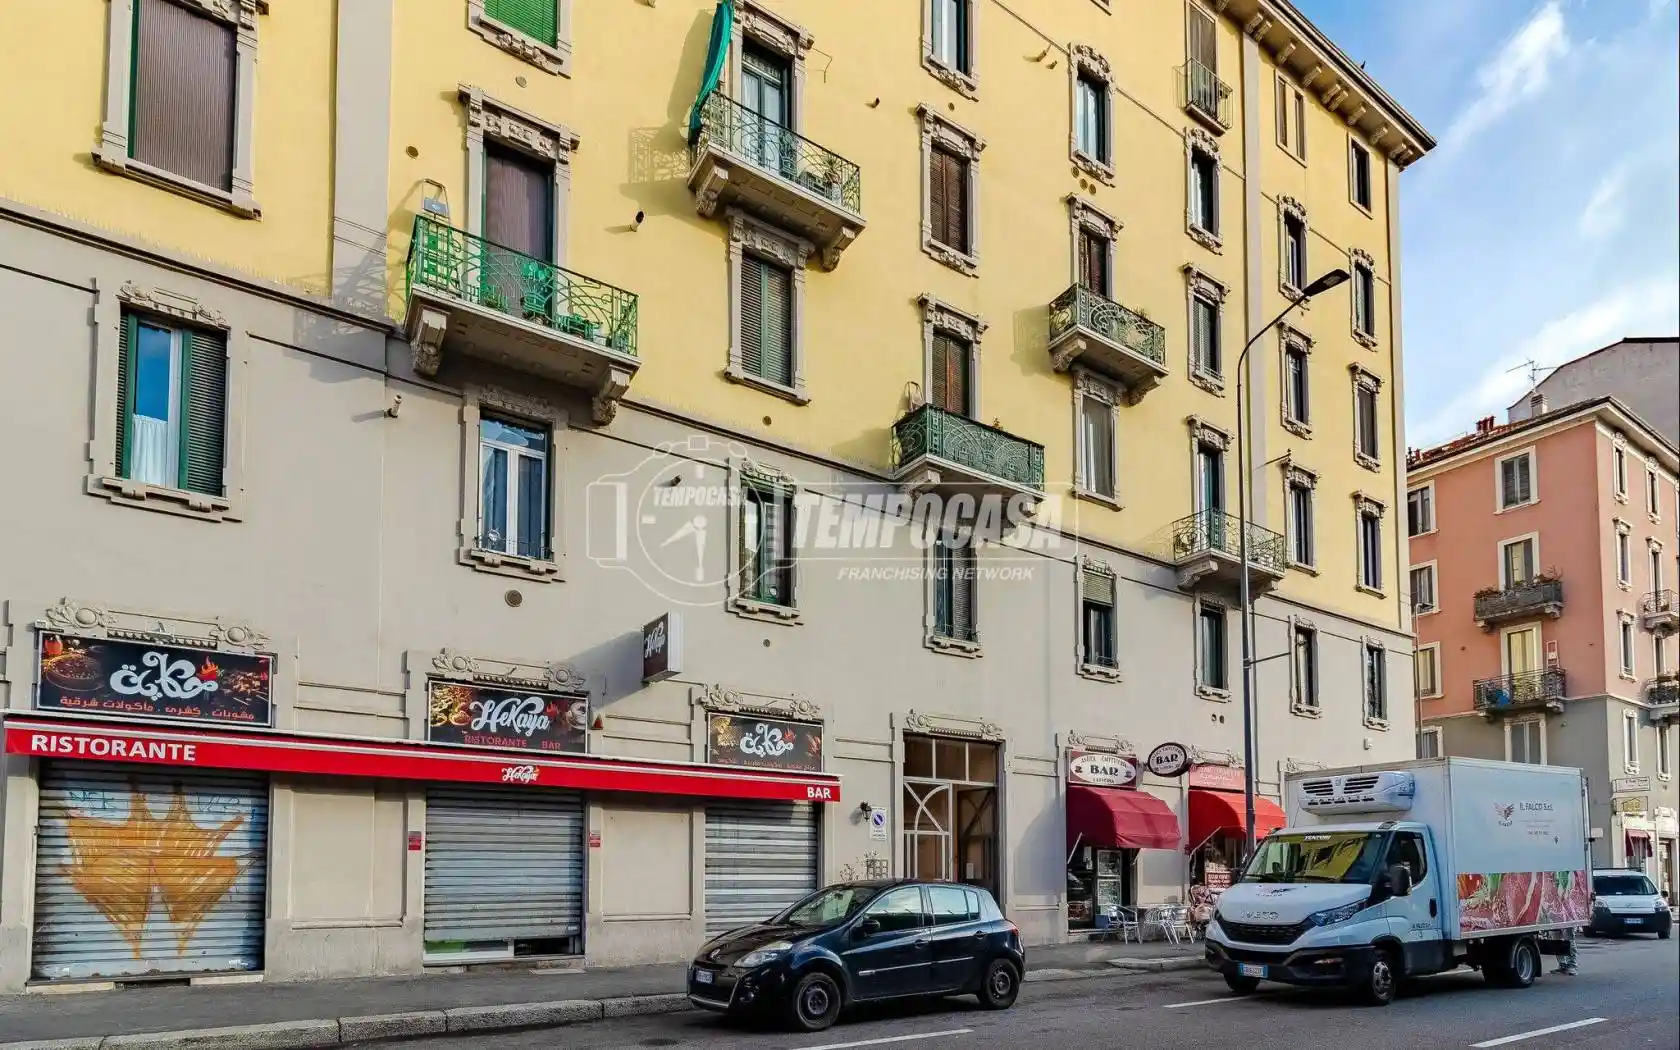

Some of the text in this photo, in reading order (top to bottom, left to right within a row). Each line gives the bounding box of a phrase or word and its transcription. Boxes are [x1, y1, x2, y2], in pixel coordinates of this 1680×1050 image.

[31, 735, 197, 761] RISTORANTE
[464, 735, 561, 750] RISTORANTE BAR
[1156, 753, 1179, 765] BAR
[1090, 764, 1119, 777] BAR
[806, 786, 831, 799] BAR
